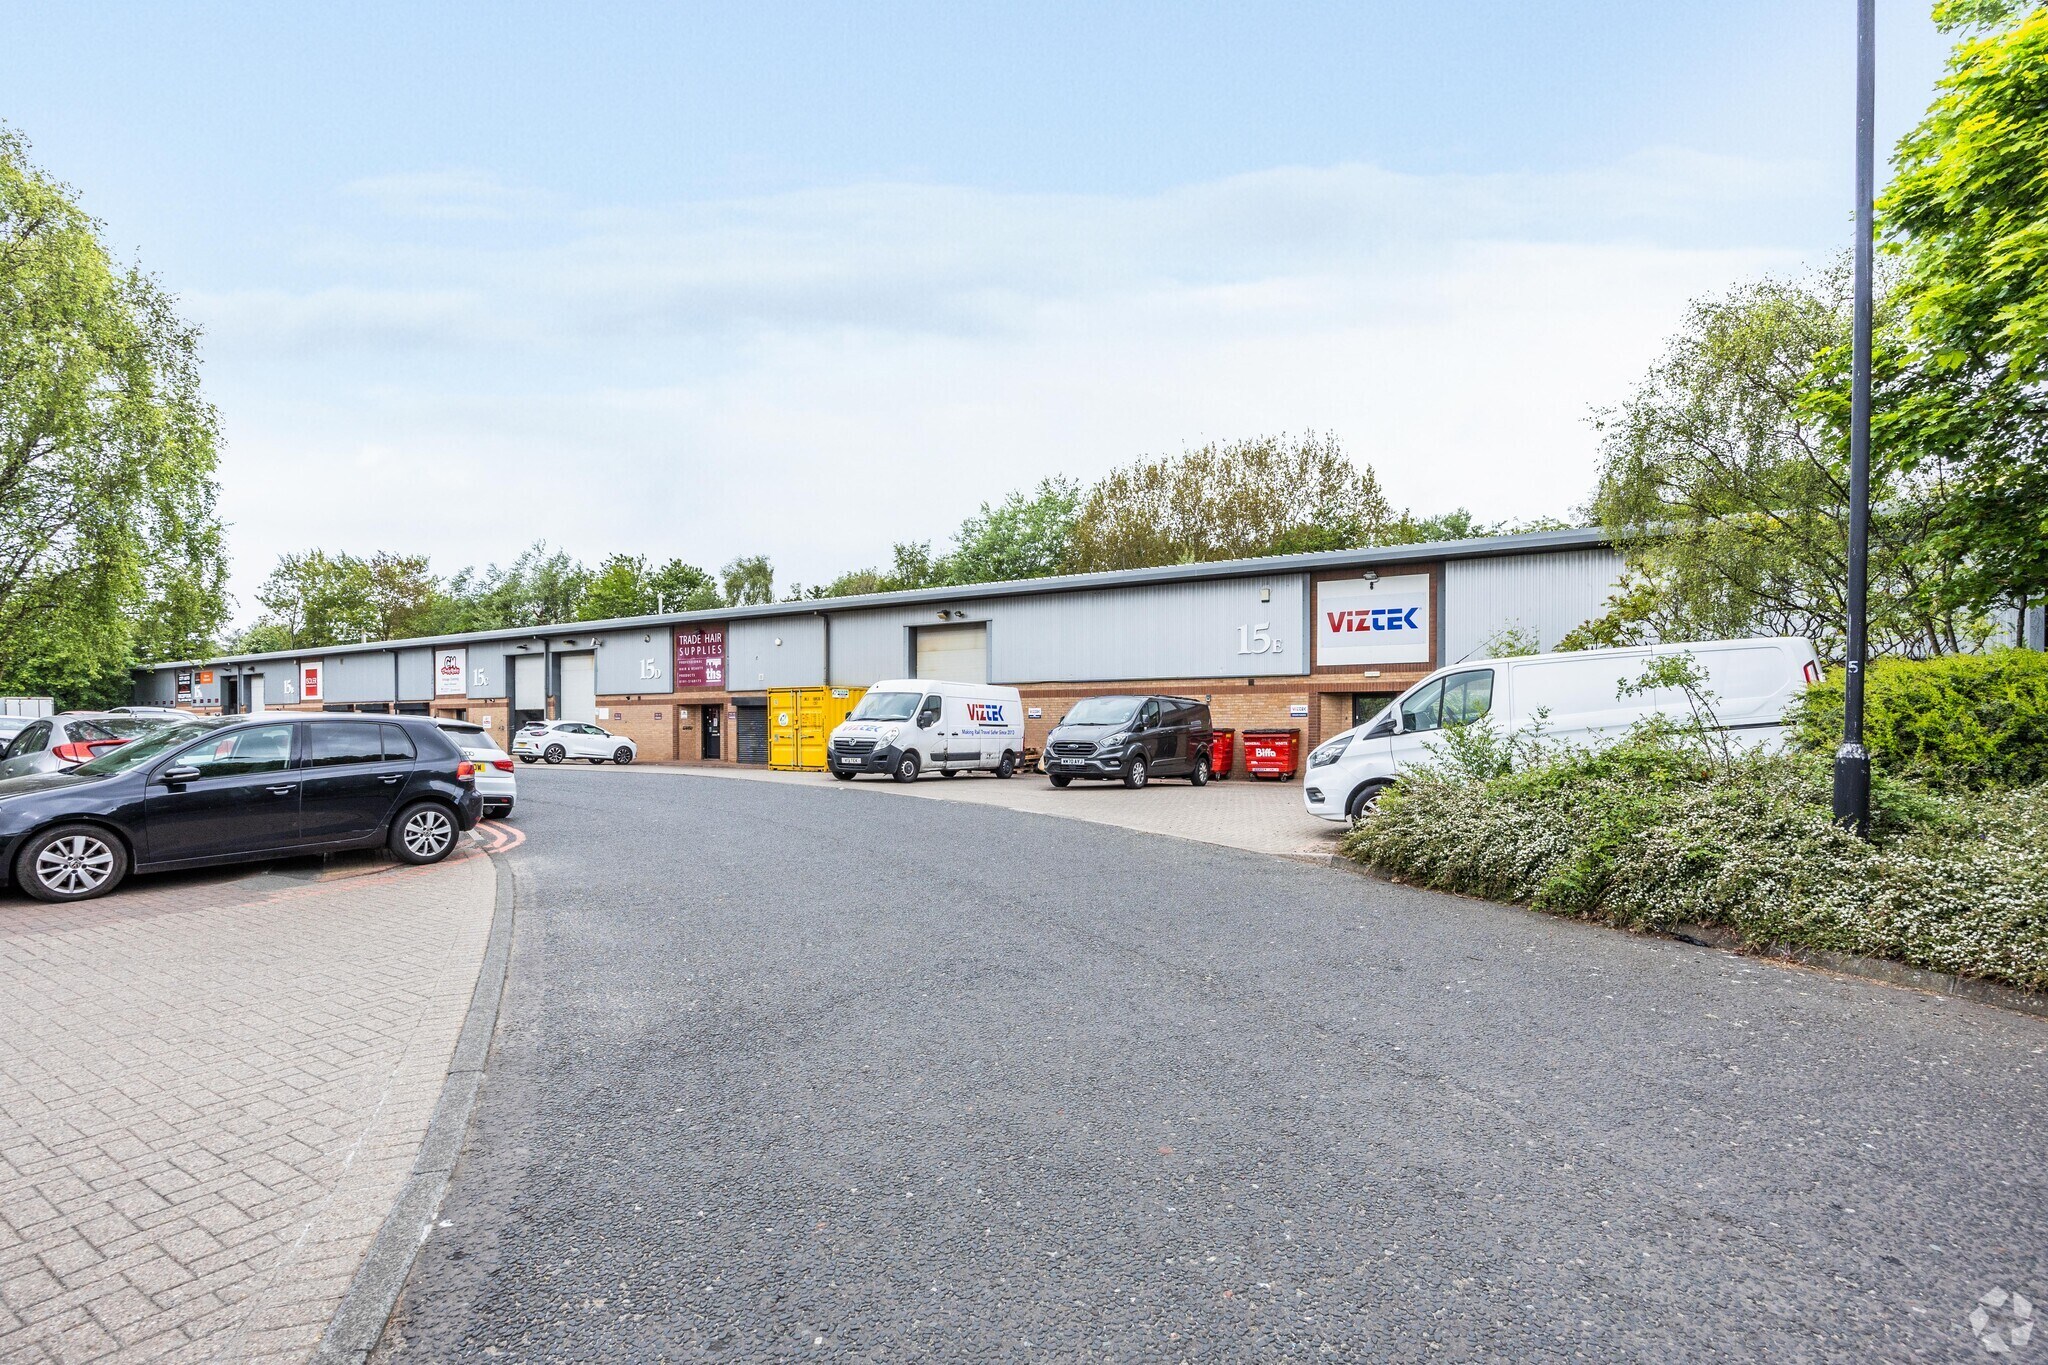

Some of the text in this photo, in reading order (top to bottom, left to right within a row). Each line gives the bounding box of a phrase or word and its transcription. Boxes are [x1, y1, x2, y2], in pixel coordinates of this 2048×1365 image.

[679, 633, 722, 644] TRADE HAIR
[679, 645, 722, 656] SUPPLIES
[1848, 660, 1859, 673] 5
[961, 729, 974, 737] Making
[1255, 748, 1277, 758] Biffa
